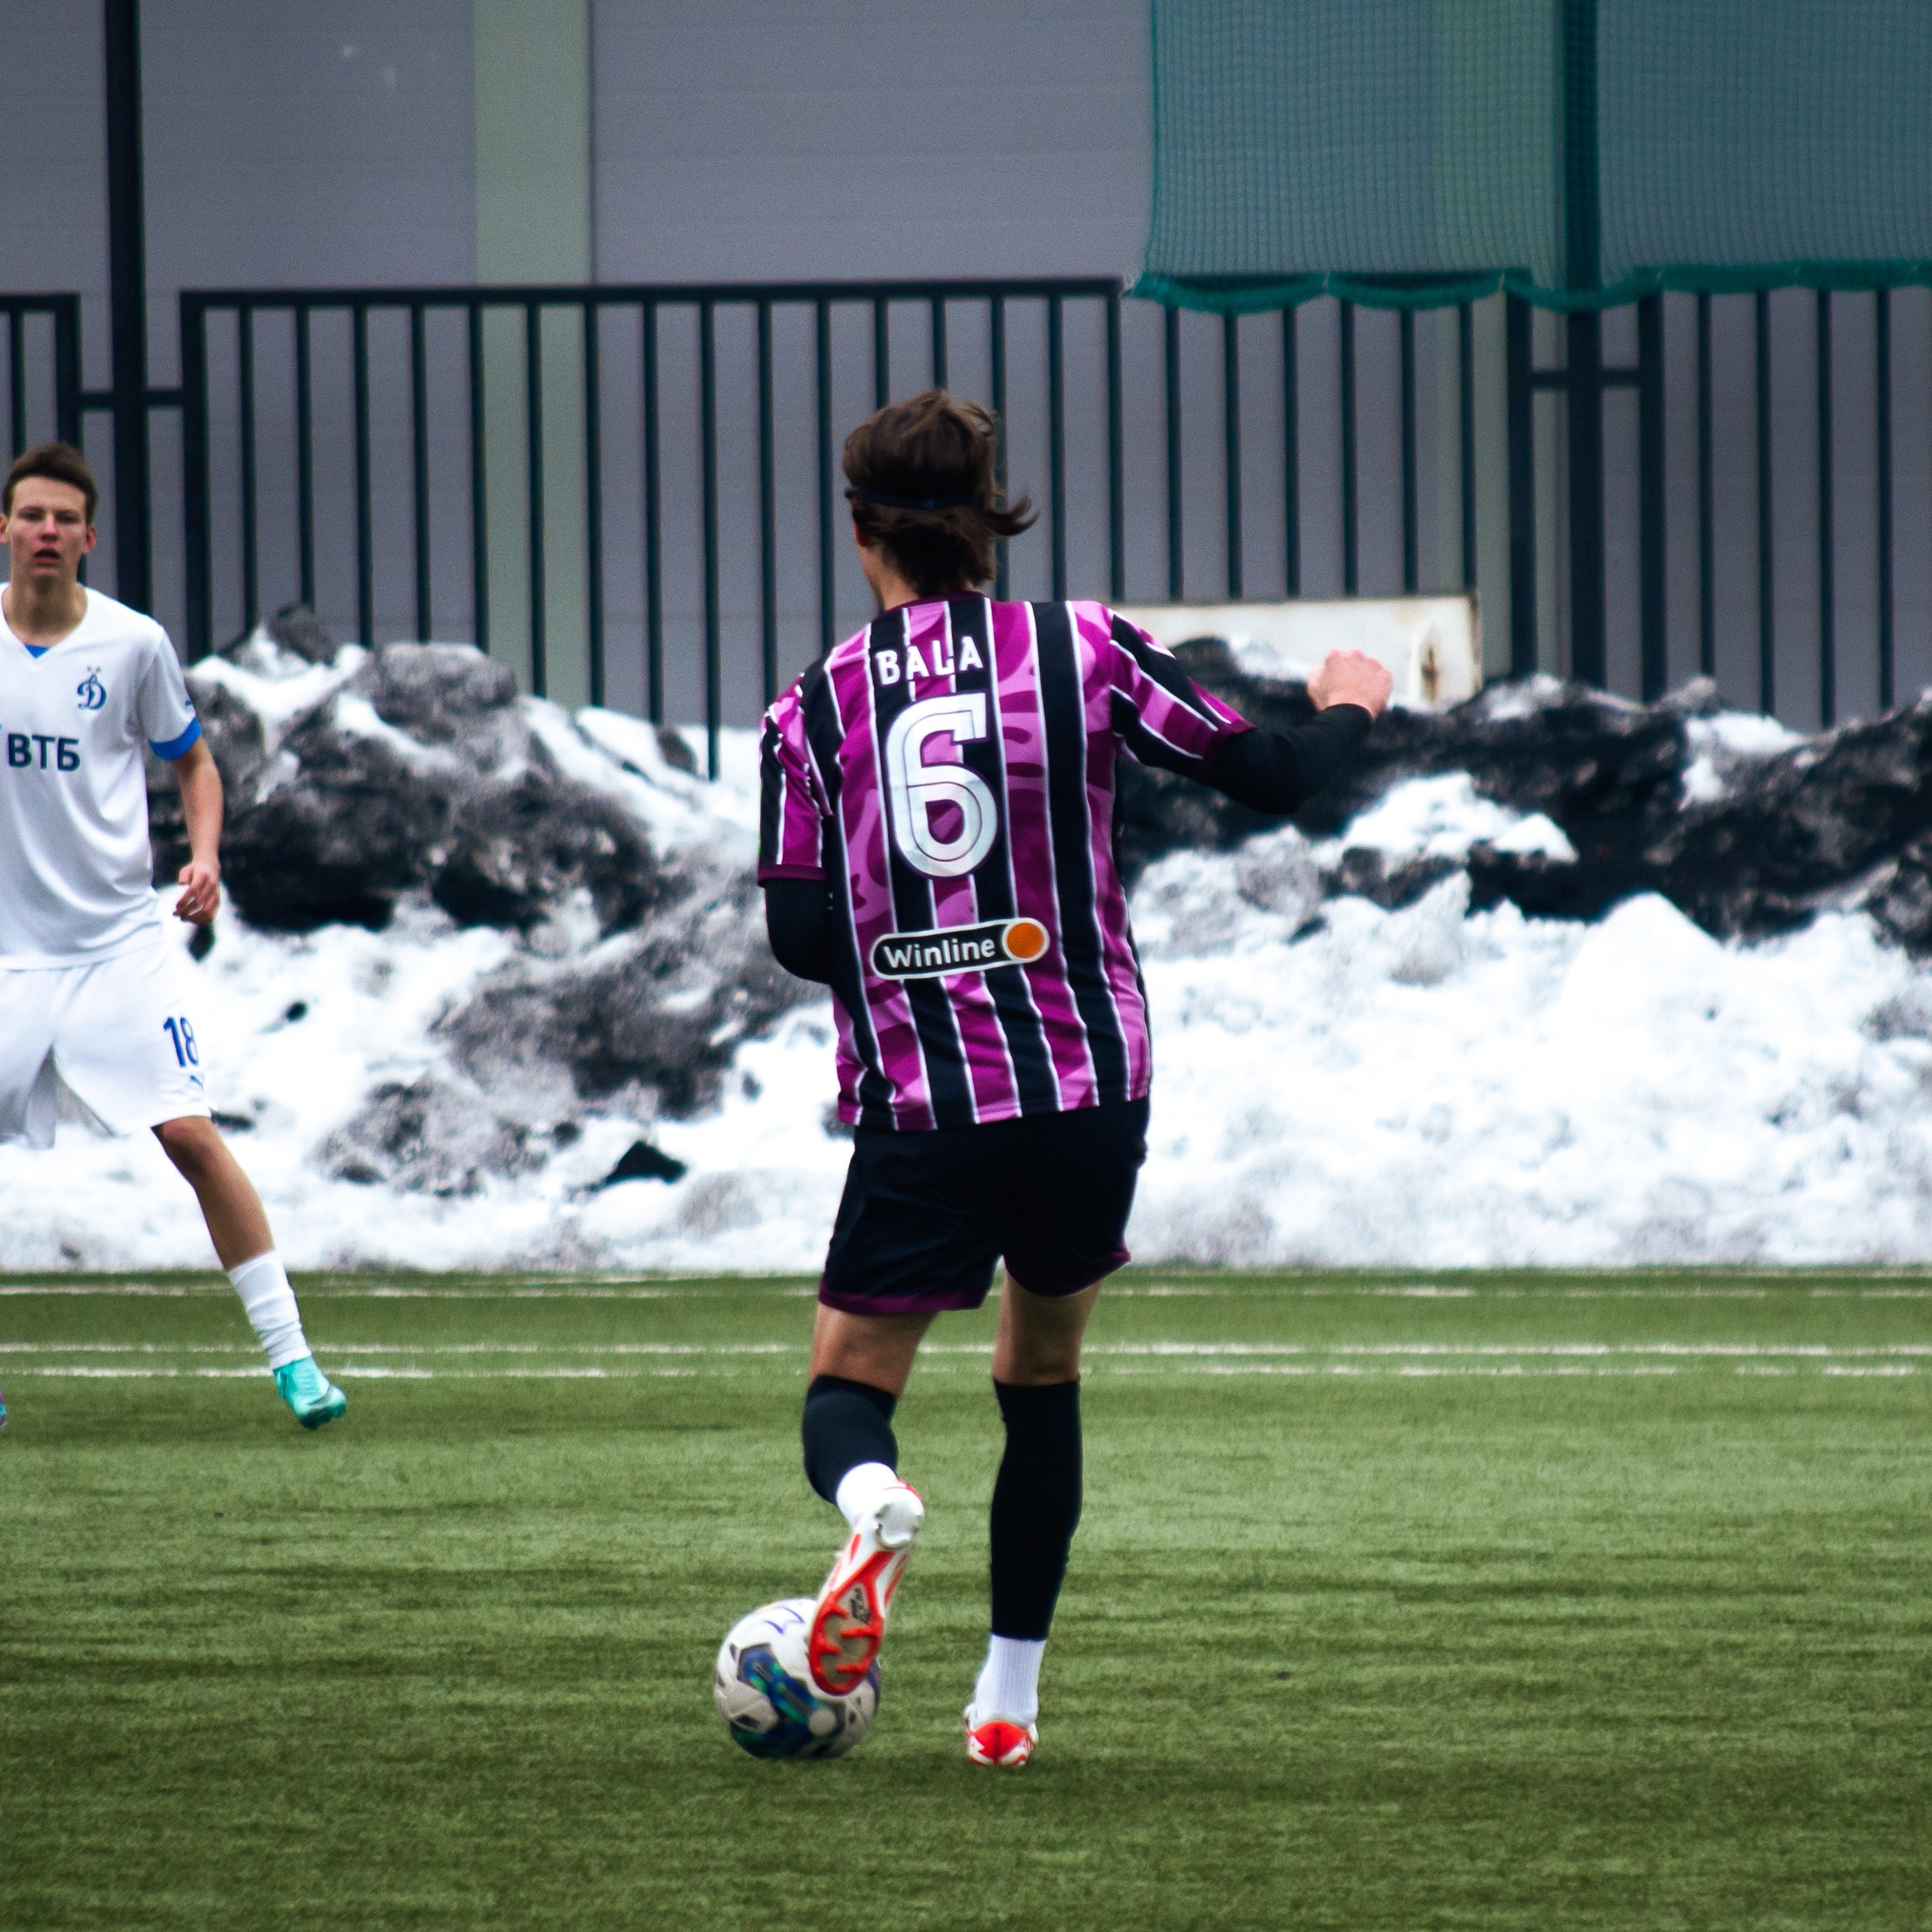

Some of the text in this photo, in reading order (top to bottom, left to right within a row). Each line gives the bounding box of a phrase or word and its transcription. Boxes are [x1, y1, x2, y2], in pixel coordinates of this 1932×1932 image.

[875, 635, 983, 685] BALA
[8, 733, 81, 771] ВТБ
[886, 693, 998, 878] 6
[883, 937, 995, 968] Winline
[163, 1017, 198, 1068] 18
